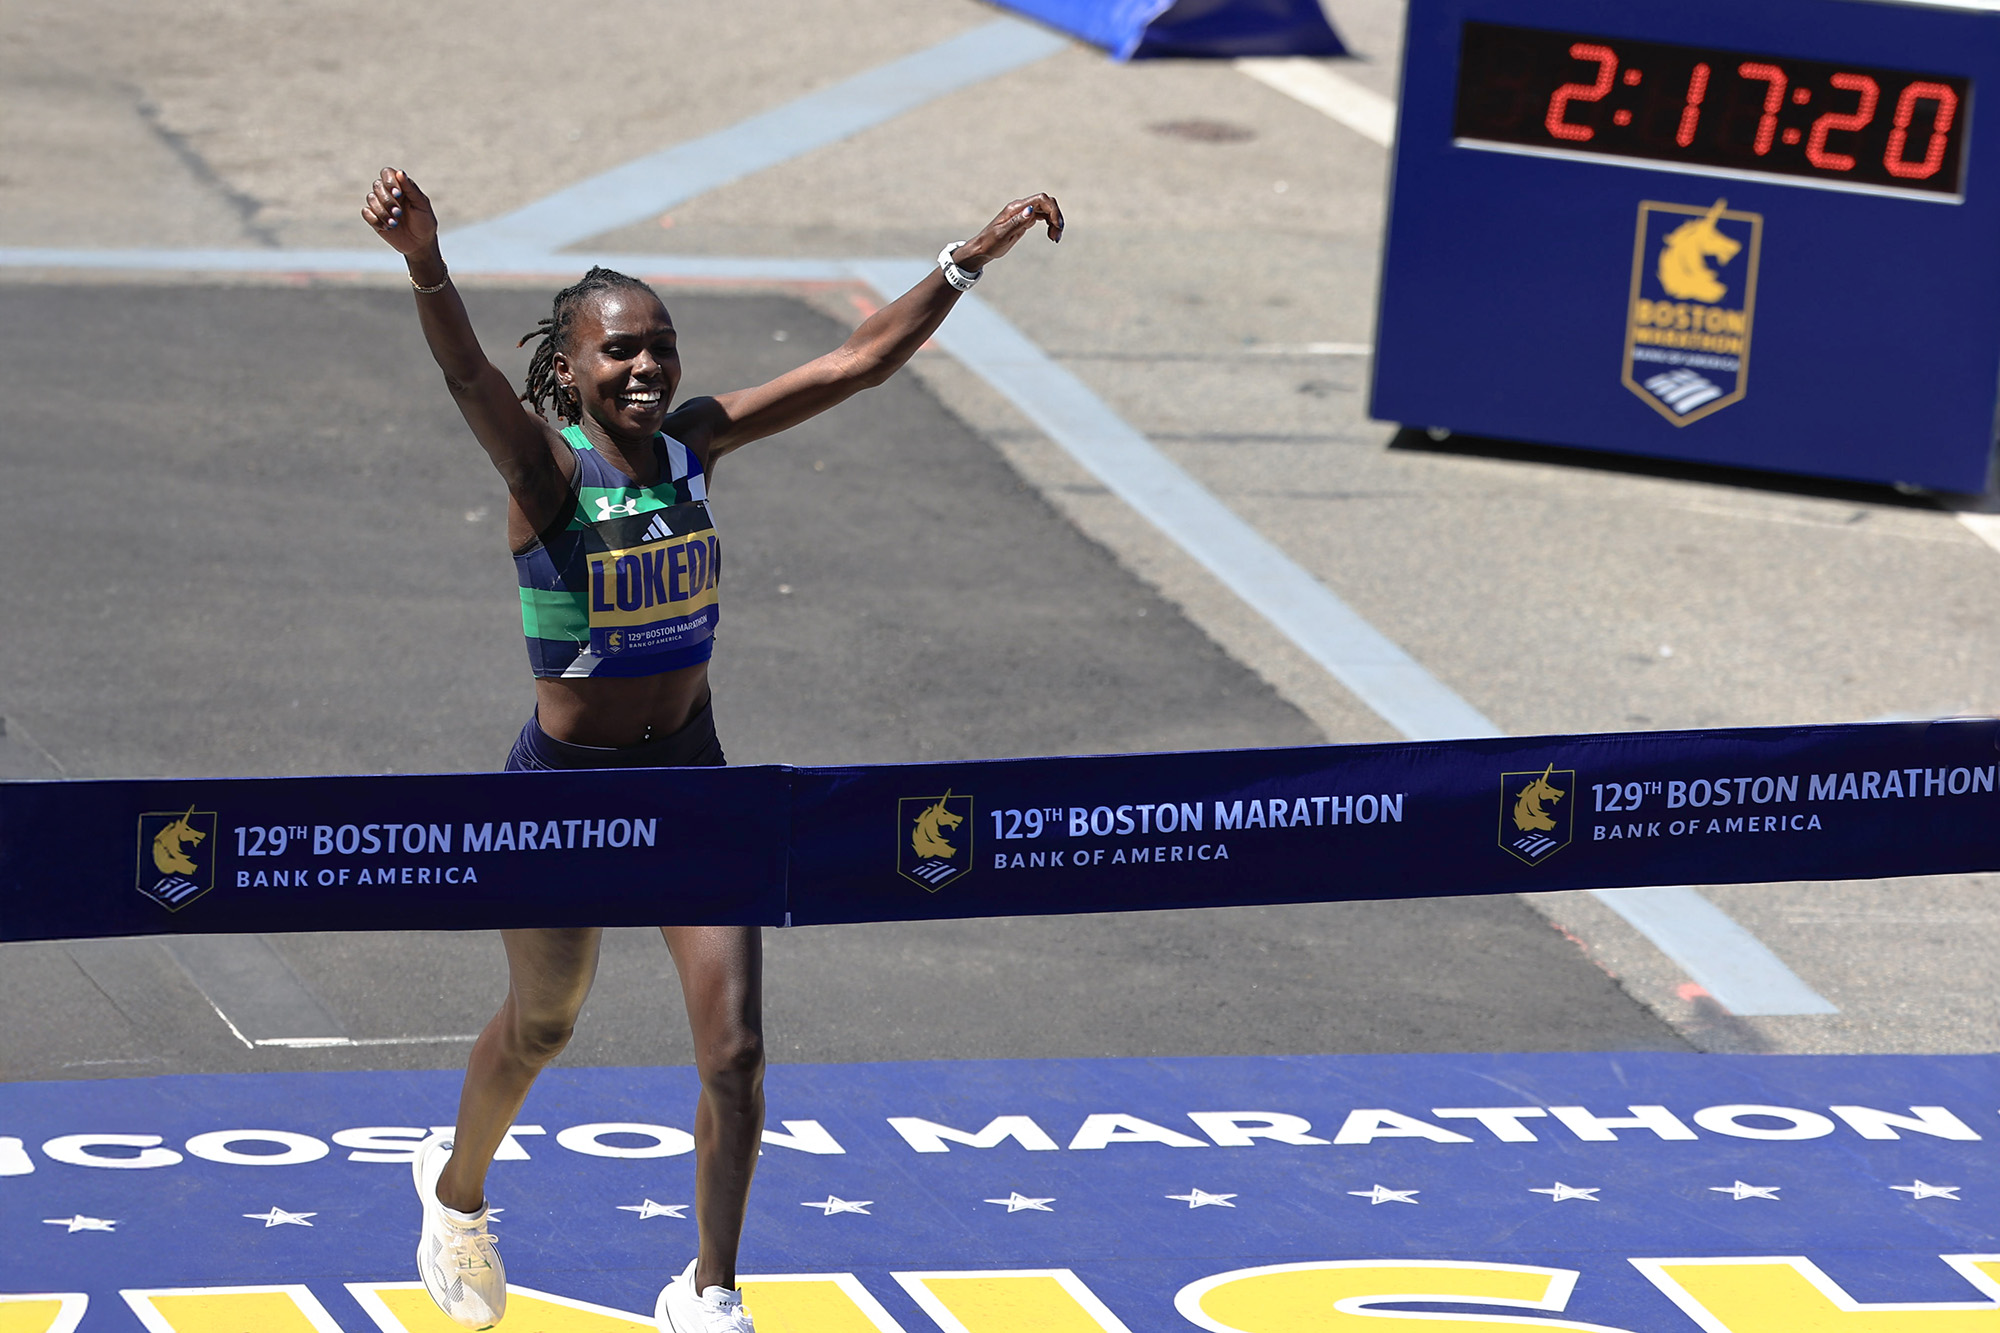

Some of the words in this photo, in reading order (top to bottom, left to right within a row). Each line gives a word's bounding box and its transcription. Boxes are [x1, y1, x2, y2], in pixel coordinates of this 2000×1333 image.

[1545, 43, 1957, 179] 2:17:20
[1634, 298, 1746, 337] BOSTON
[592, 535, 716, 612] LOKEDI
[628, 640, 647, 648] BANK
[655, 634, 683, 644] AMERICA
[645, 625, 676, 640] BOSTON
[676, 614, 708, 633] MARATHON
[1667, 775, 1799, 809] BOSTON
[1808, 765, 1996, 801] MARATHON
[1069, 802, 1201, 837] BOSTON
[1213, 793, 1403, 830] MARATHON
[1593, 822, 1661, 841] BANK
[1669, 820, 1700, 835] OF
[1706, 813, 1823, 834] AMERICA
[313, 823, 452, 855] BOSTON
[462, 818, 657, 853] MARATHON
[993, 852, 1064, 869] BANK
[1072, 848, 1105, 866] OF
[1111, 844, 1229, 864] AMERICA
[236, 870, 309, 888] BANK
[316, 868, 350, 886] OF
[357, 866, 479, 885] AMERICA
[886, 1104, 1984, 1152] MARATHON
